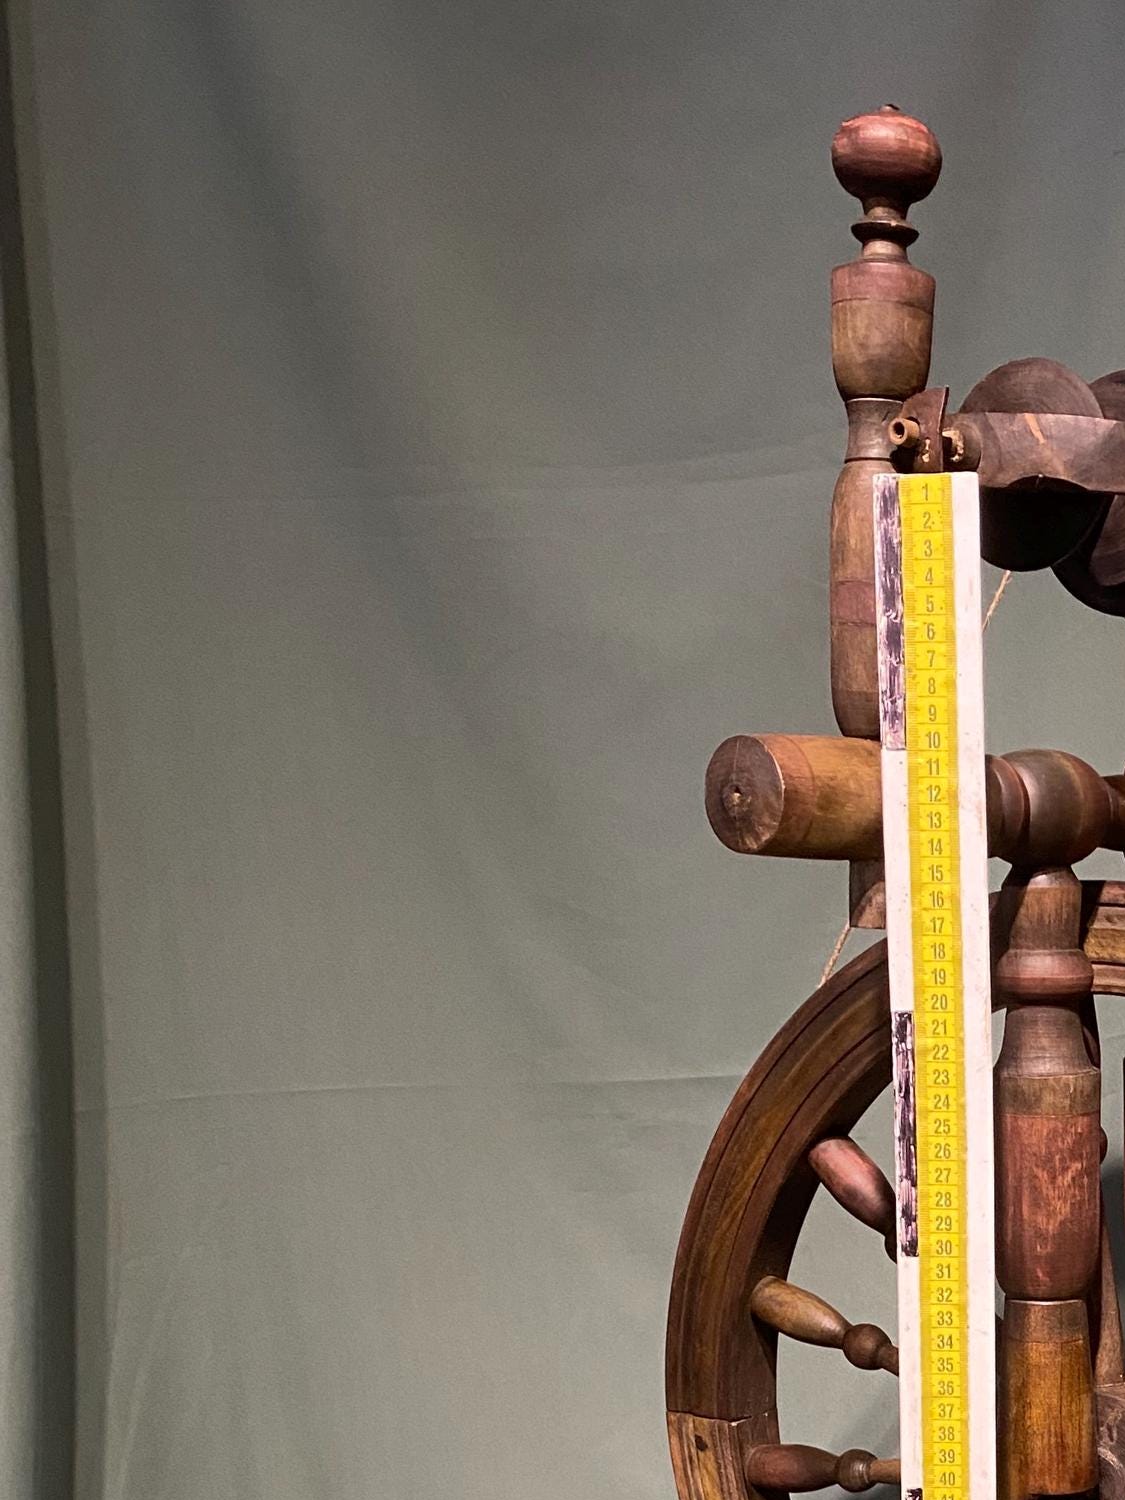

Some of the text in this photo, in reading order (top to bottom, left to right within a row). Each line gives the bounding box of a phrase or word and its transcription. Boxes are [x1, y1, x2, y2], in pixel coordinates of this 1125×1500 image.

[921, 483, 929, 502] 1
[922, 511, 932, 529] 2
[923, 538, 933, 558] 3
[924, 566, 934, 586] 4
[925, 594, 935, 613] 5
[926, 621, 936, 640] 6
[926, 649, 936, 668] 7
[927, 676, 937, 695] 8
[928, 703, 937, 722] 9
[924, 731, 941, 749] 10
[925, 757, 940, 776] 11
[925, 784, 942, 802] 12
[925, 811, 942, 829] 13
[927, 837, 943, 855] 14
[927, 864, 944, 882] 15
[928, 890, 945, 908] 16
[927, 916, 945, 934] 17
[929, 942, 946, 960] 18
[930, 967, 947, 985] 19
[930, 993, 948, 1011] 20
[931, 1018, 948, 1035] 21
[932, 1043, 950, 1061] 22
[932, 1068, 950, 1085] 23
[933, 1093, 951, 1111] 24
[933, 1117, 951, 1135] 25
[934, 1142, 952, 1159] 26
[934, 1167, 952, 1183] 27
[935, 1191, 953, 1208] 28
[935, 1215, 953, 1232] 29
[935, 1239, 953, 1256] 30
[935, 1263, 951, 1280] 31
[935, 1286, 953, 1303] 32
[936, 1310, 954, 1326] 33
[936, 1333, 954, 1350] 34
[936, 1356, 954, 1373] 35
[937, 1380, 955, 1396] 36
[937, 1402, 955, 1419] 37
[938, 1425, 955, 1442] 38
[938, 1448, 956, 1464] 39
[939, 1471, 956, 1487] 40
